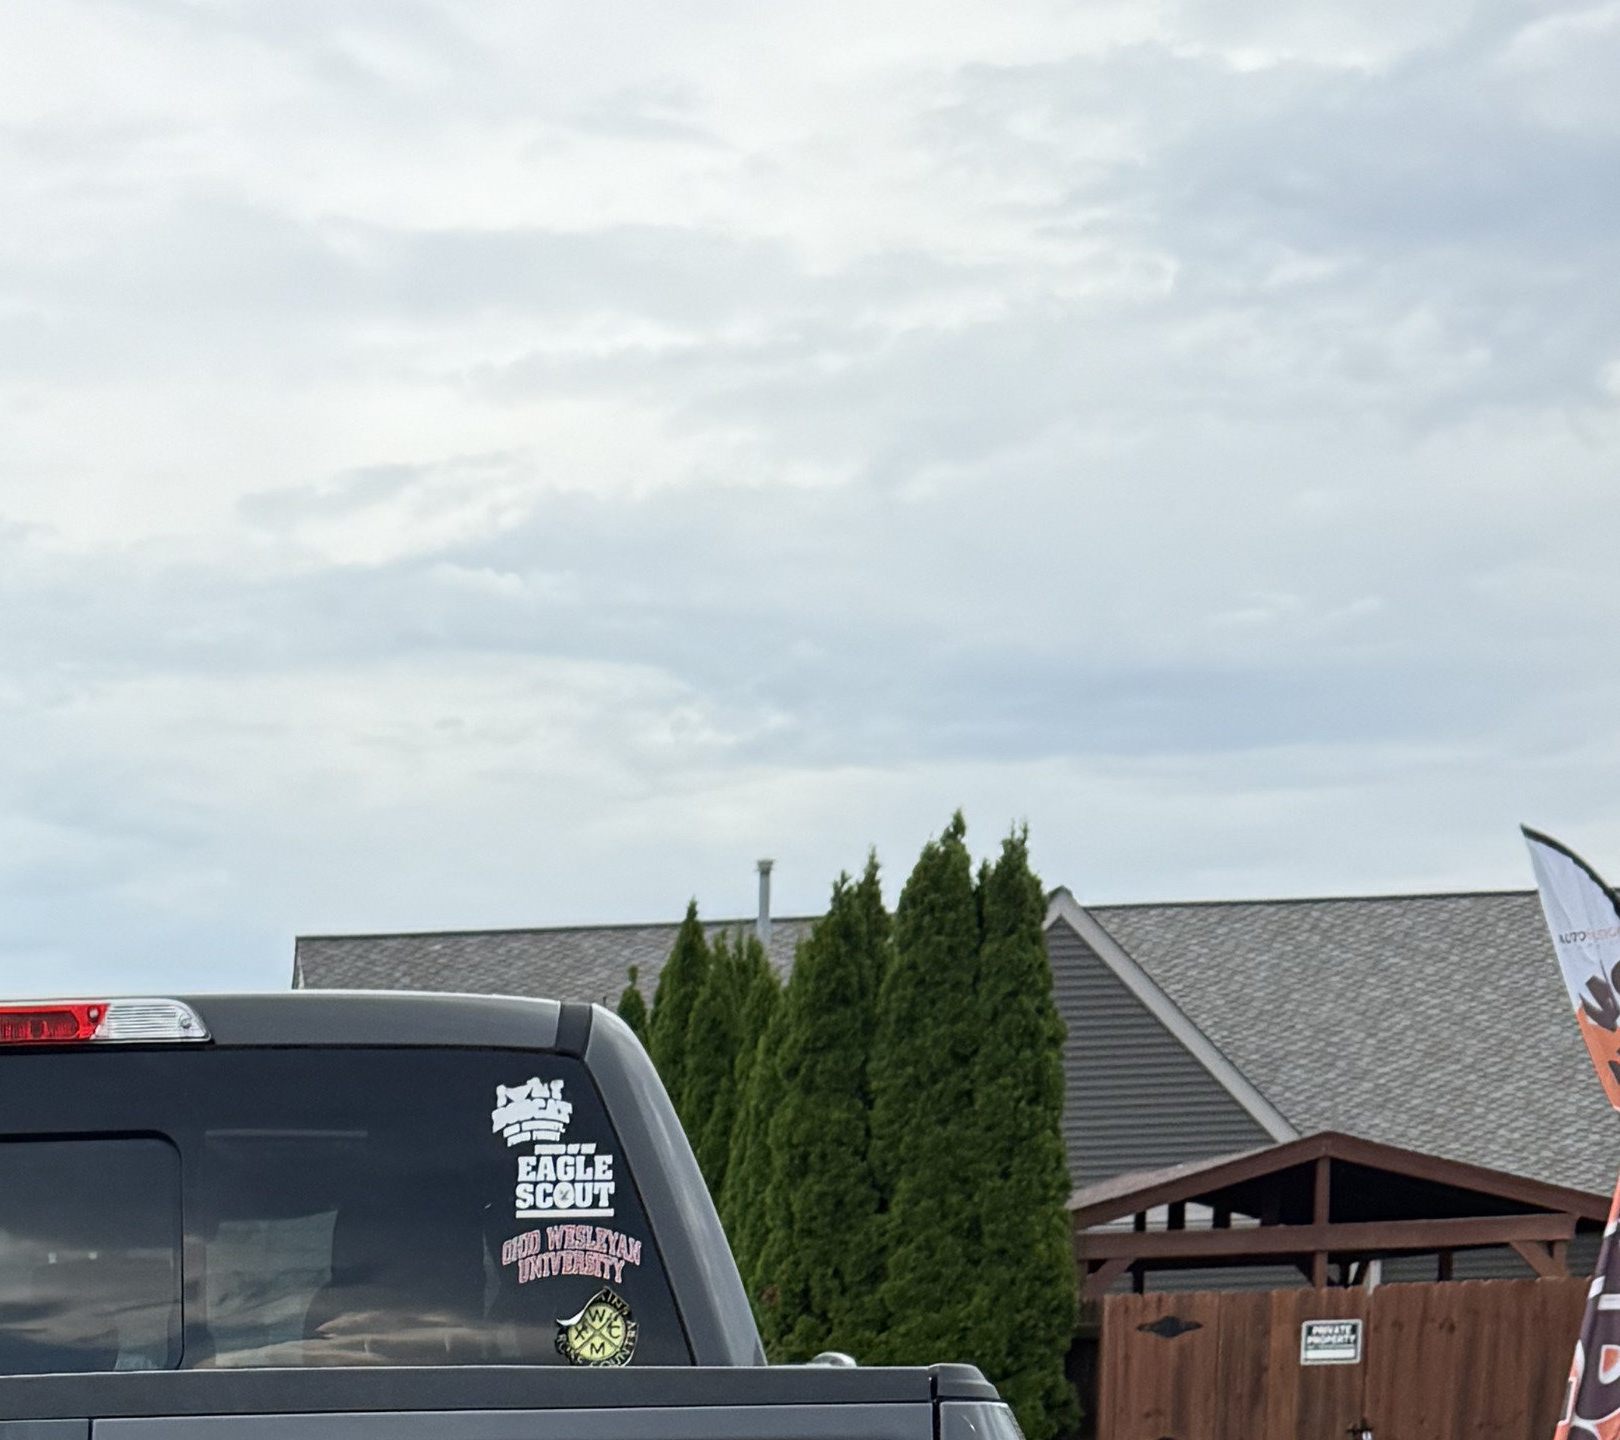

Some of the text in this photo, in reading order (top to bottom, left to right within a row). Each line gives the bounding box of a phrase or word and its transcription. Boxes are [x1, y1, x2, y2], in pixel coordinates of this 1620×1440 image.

[517, 1154, 614, 1182] EAGLE
[515, 1181, 616, 1209] SCOUT
[501, 1224, 642, 1267] OHIO WESLEYAN
[518, 1249, 626, 1285] UNIVERSITY
